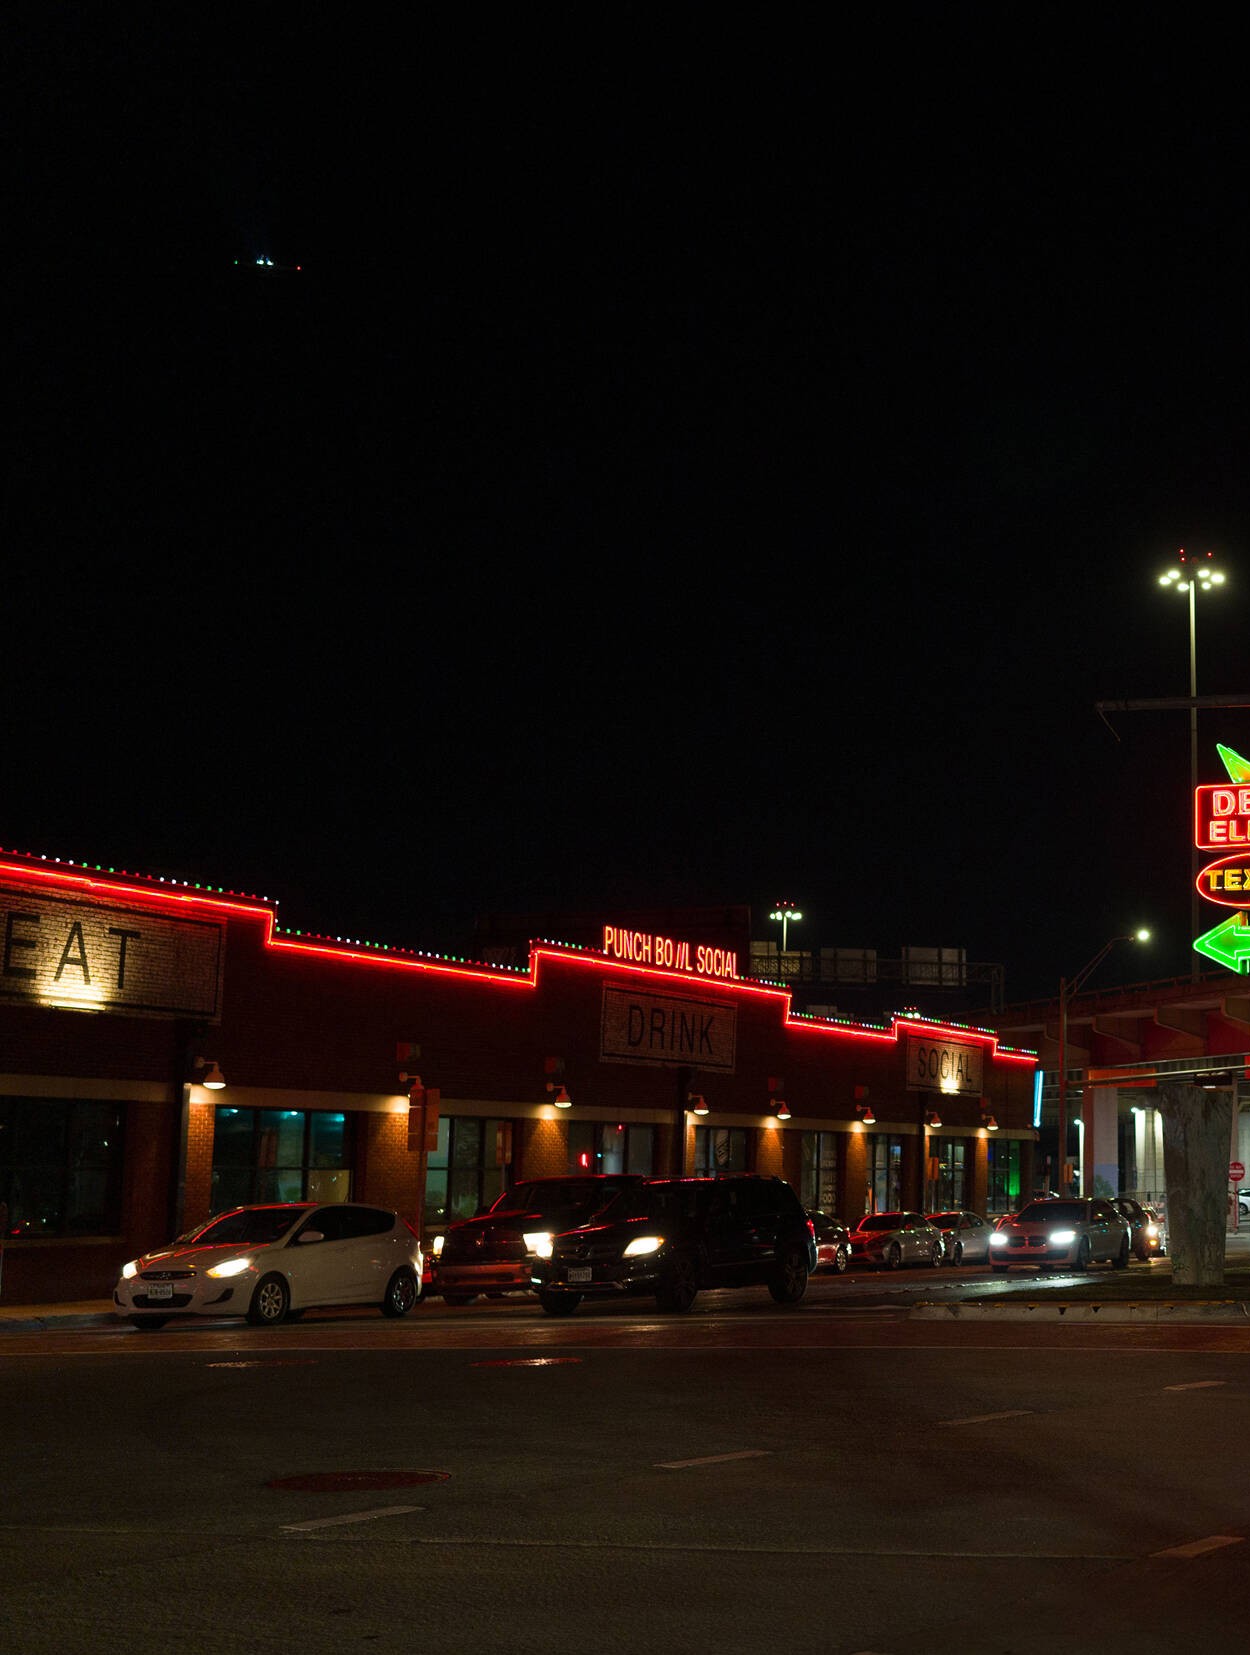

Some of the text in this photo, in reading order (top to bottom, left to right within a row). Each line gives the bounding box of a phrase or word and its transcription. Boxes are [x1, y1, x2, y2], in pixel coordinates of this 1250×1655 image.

[4, 911, 140, 989] EAT
[604, 925, 652, 963] PUNCH
[696, 945, 740, 980] SOCIAL
[627, 1004, 715, 1055] DRINK
[918, 1047, 972, 1083] SOCIAL
